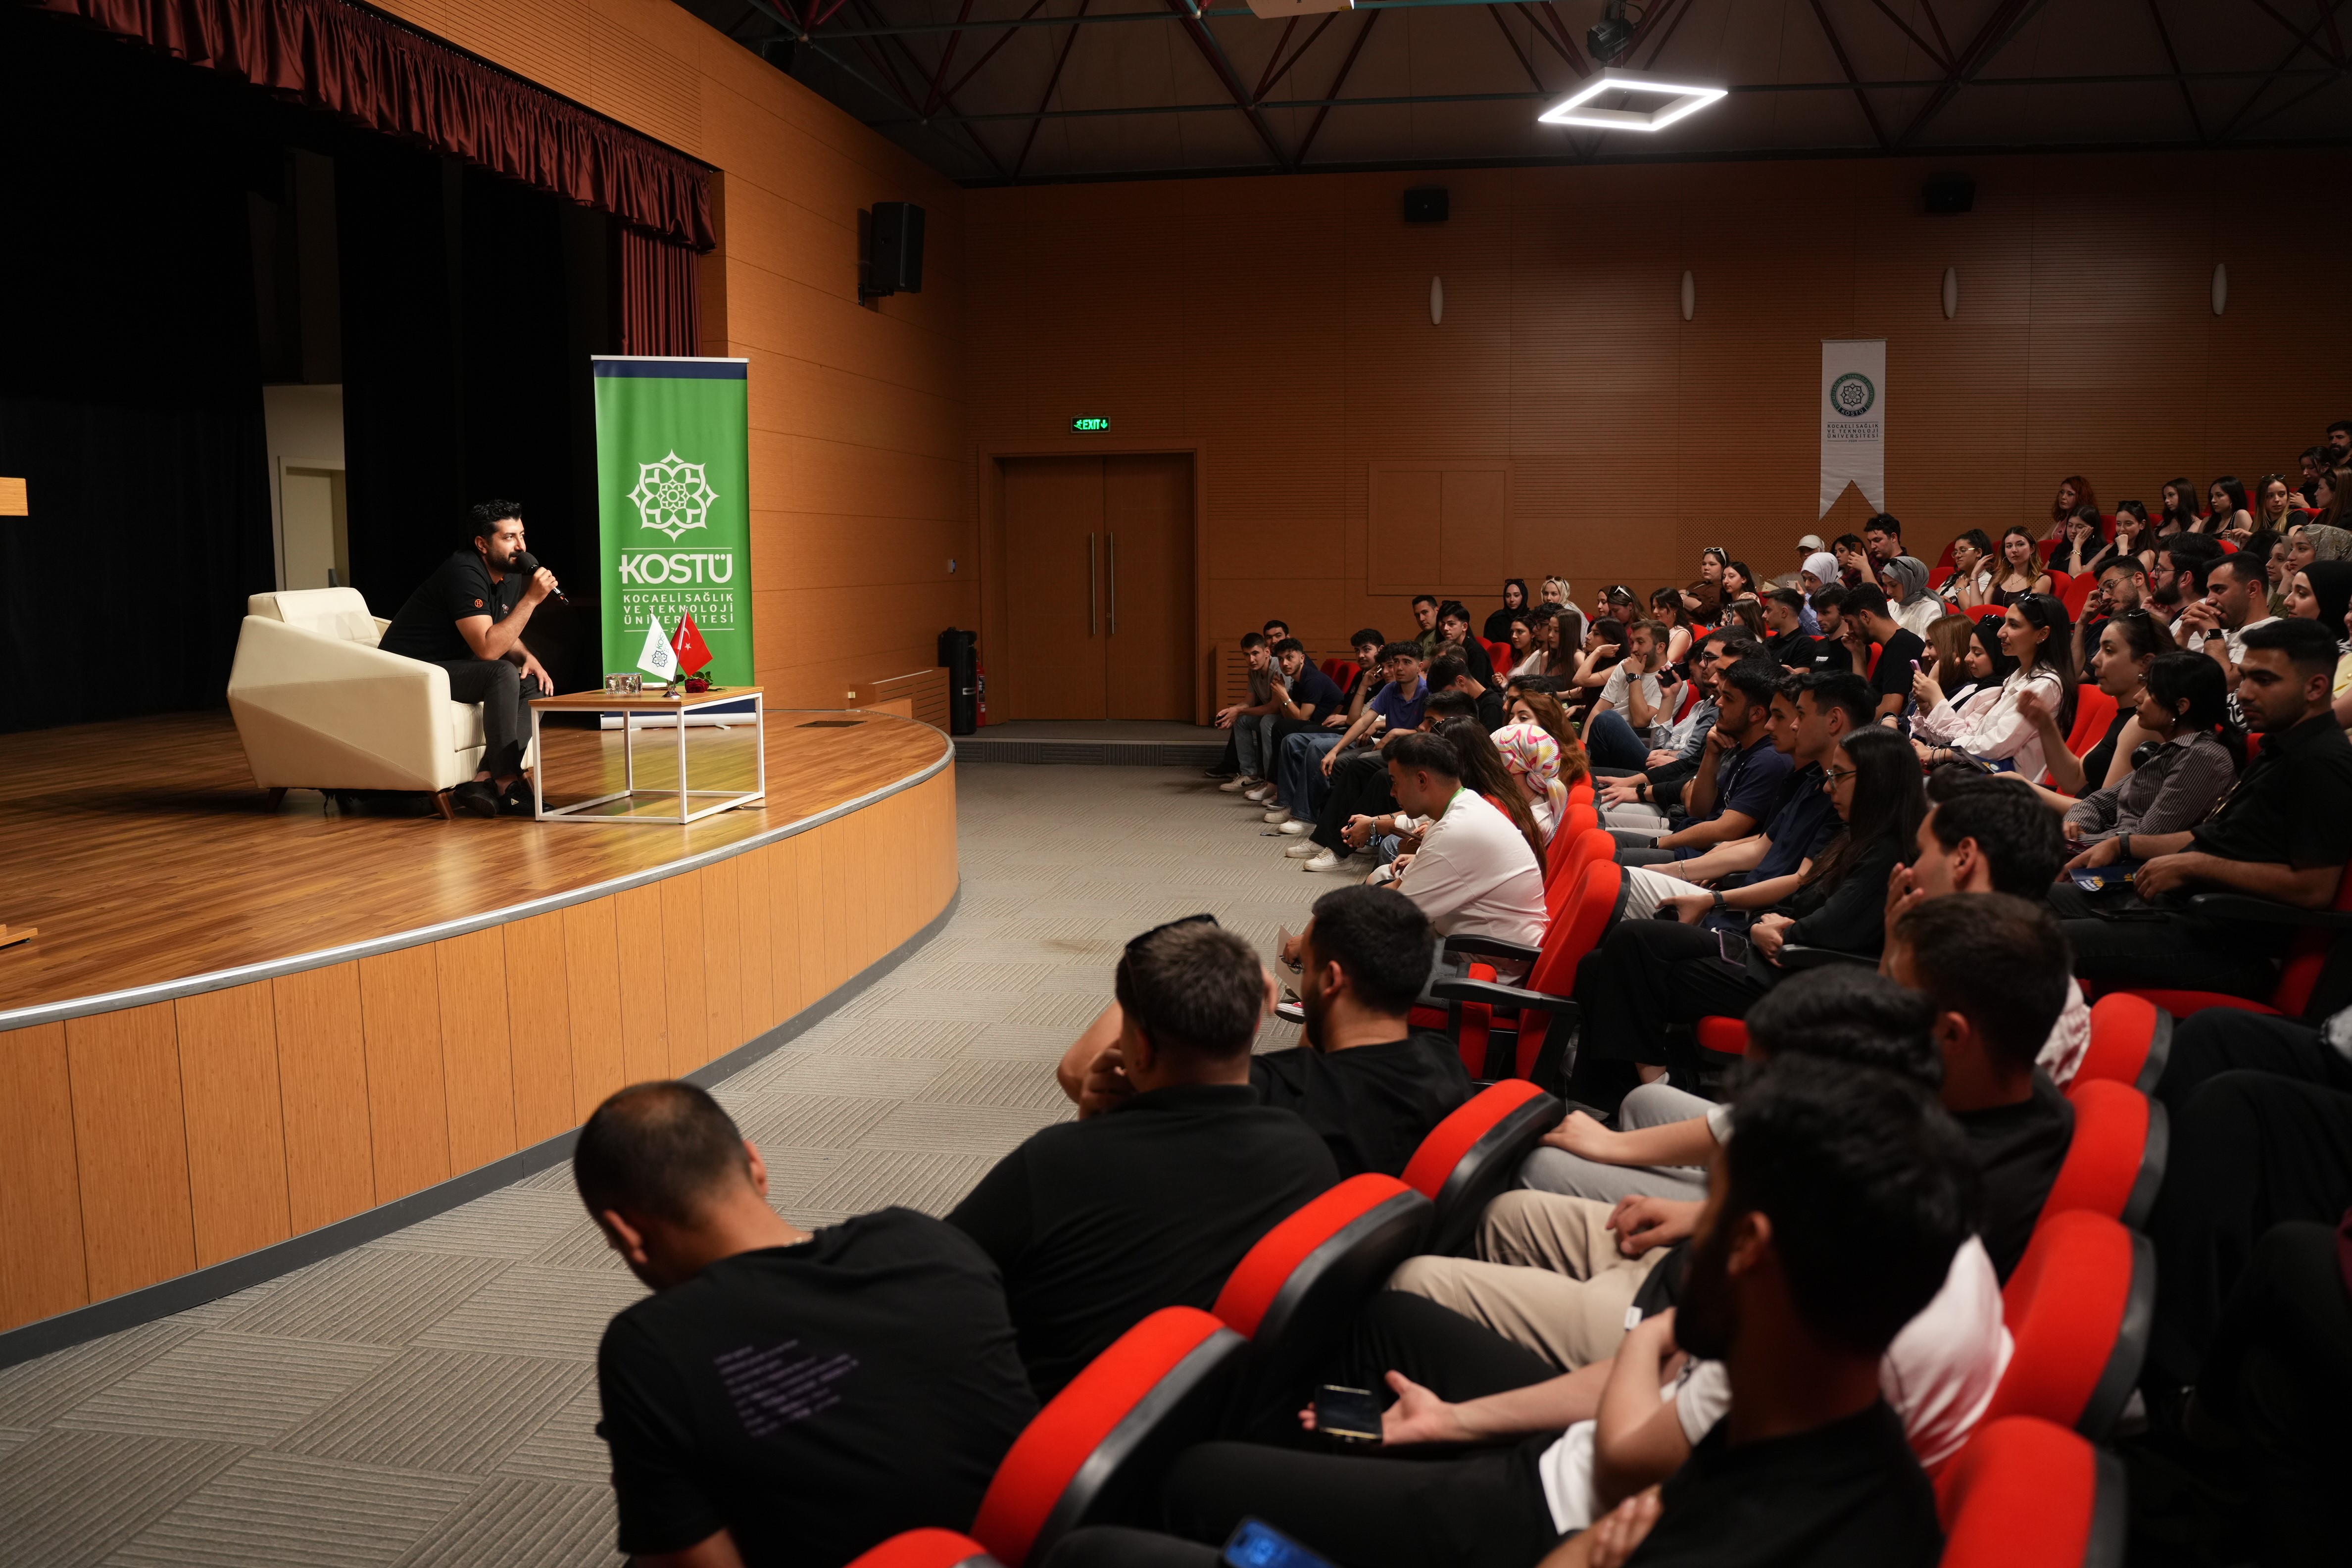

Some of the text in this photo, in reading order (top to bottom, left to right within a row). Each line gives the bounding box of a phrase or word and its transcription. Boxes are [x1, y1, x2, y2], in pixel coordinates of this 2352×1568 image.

[1083, 419, 1100, 430] EXIT
[619, 553, 733, 584] KOSTÜ
[623, 592, 733, 603] KOCAELİ SAĞLIK
[624, 603, 733, 614] VE TEKNOLOJİ
